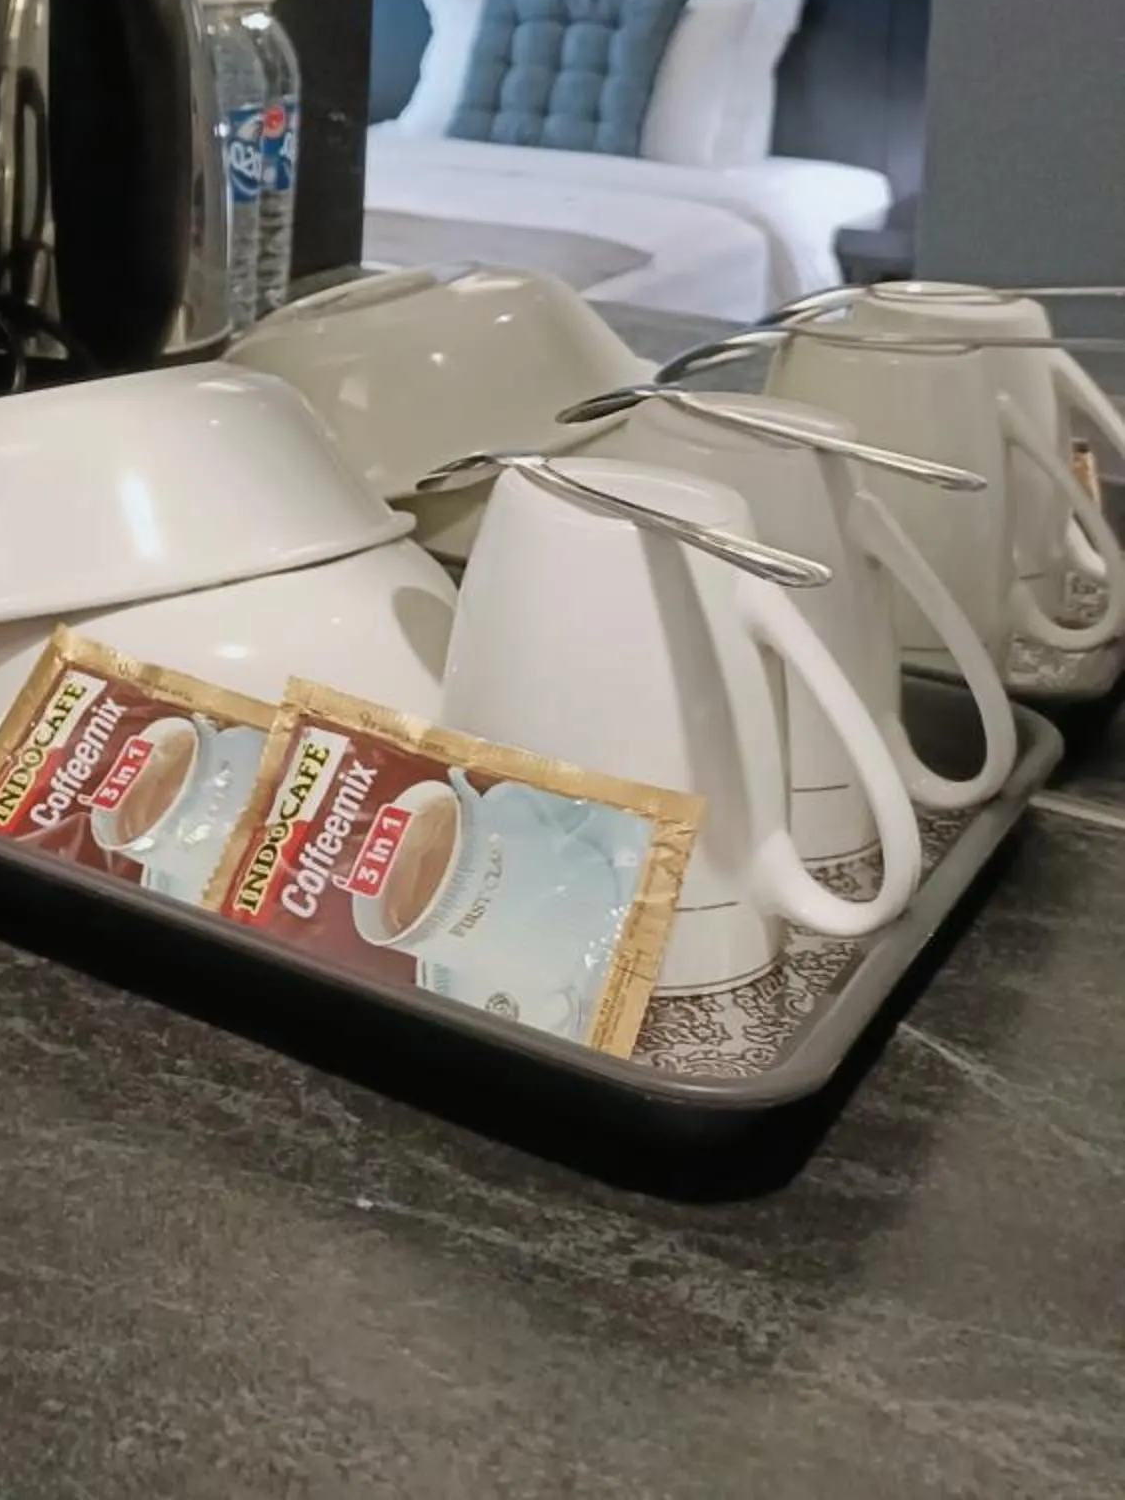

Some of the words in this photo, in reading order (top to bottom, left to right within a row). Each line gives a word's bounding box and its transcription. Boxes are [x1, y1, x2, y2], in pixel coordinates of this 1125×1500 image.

[30, 697, 127, 828] Coffeemix
[98, 787, 120, 801] 3
[128, 746, 145, 760] 1
[281, 759, 378, 919] Coffeemix
[357, 866, 381, 885] 3
[382, 816, 402, 832] 1
